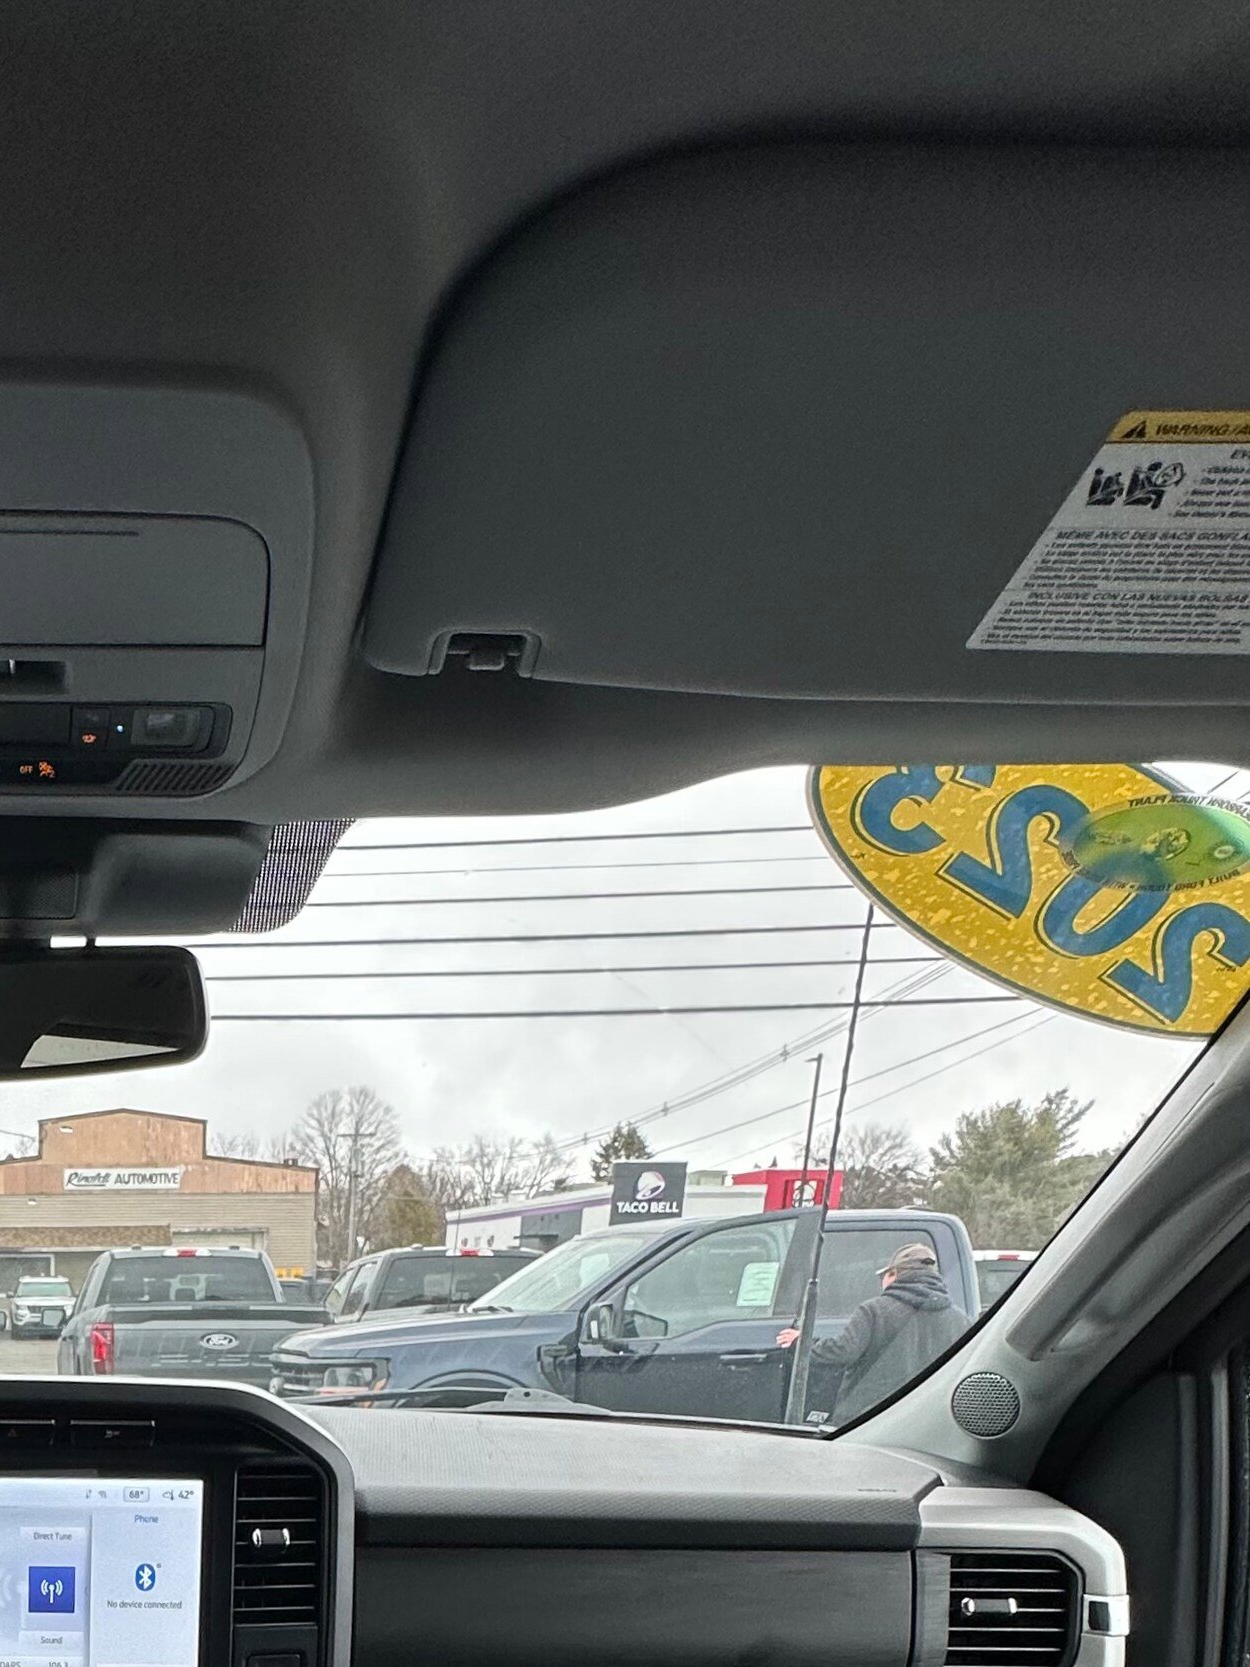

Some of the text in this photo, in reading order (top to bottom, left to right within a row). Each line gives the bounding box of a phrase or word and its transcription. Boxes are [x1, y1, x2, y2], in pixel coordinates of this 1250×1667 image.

[19, 764, 33, 775] OFF
[114, 1173, 179, 1185] AUTOMOTIVE
[616, 1200, 679, 1214] TACO BELL
[129, 1490, 144, 1499] 68°
[178, 1490, 195, 1499] 42°
[134, 1515, 159, 1524] Phone
[33, 1532, 72, 1541] Direct Tune
[107, 1600, 182, 1609] No device connected
[40, 1636, 63, 1645] Sound
